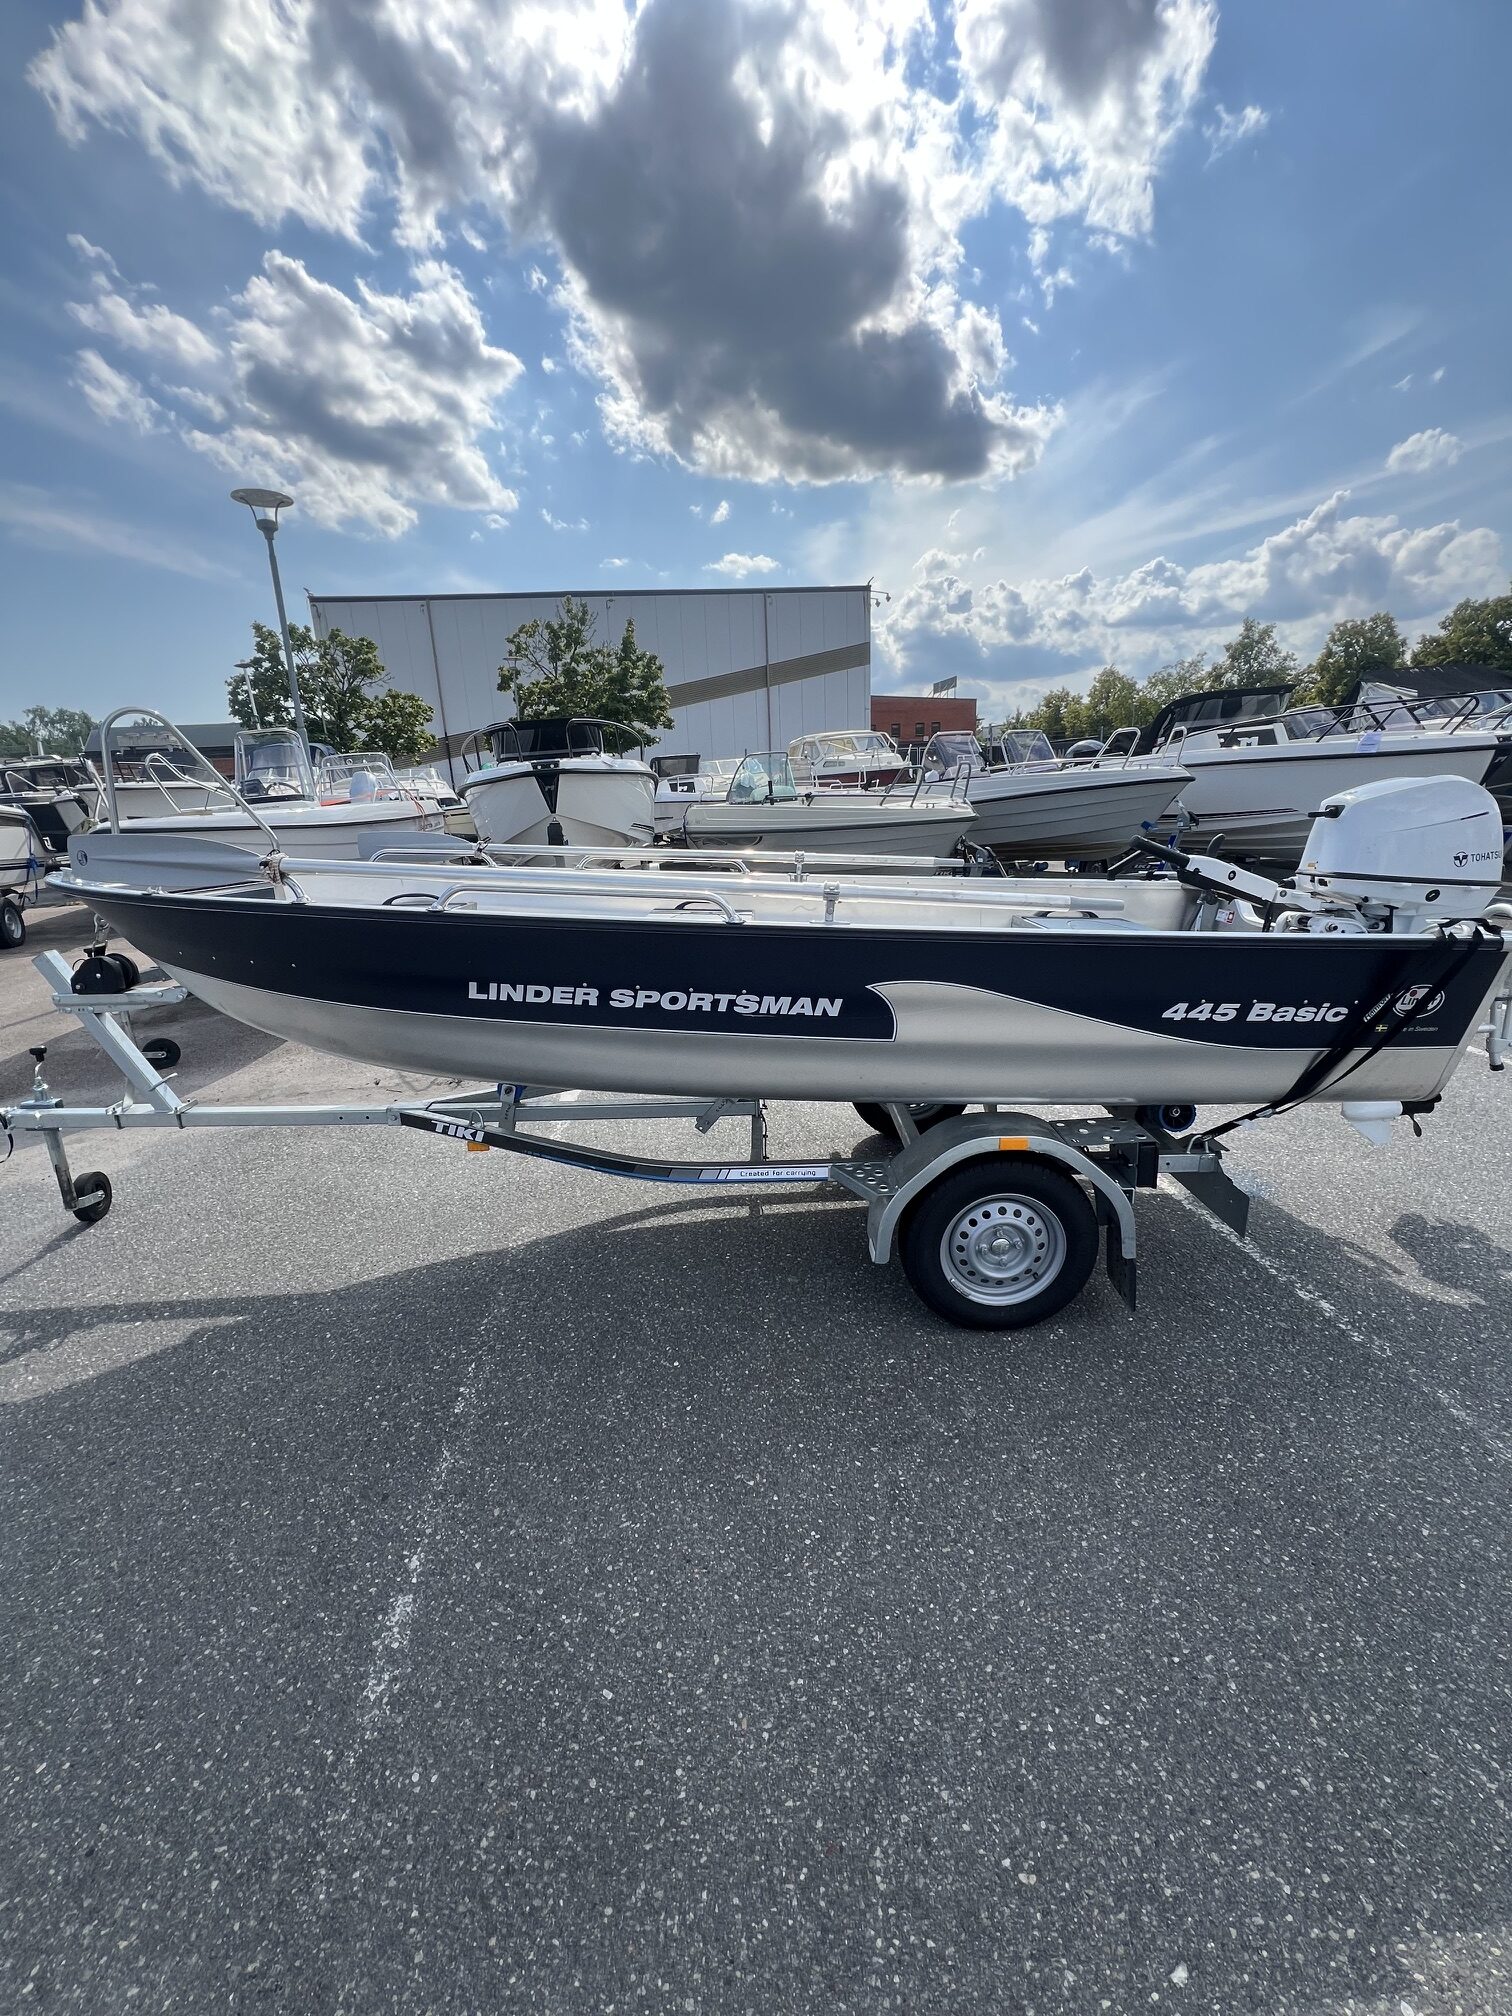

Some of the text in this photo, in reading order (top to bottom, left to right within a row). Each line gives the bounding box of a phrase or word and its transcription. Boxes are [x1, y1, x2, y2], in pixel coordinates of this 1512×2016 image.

[468, 981, 843, 1017] LINDER SPORTSMAN
[1161, 1002, 1349, 1022] 445 Basic
[431, 1120, 485, 1142] TIKI
